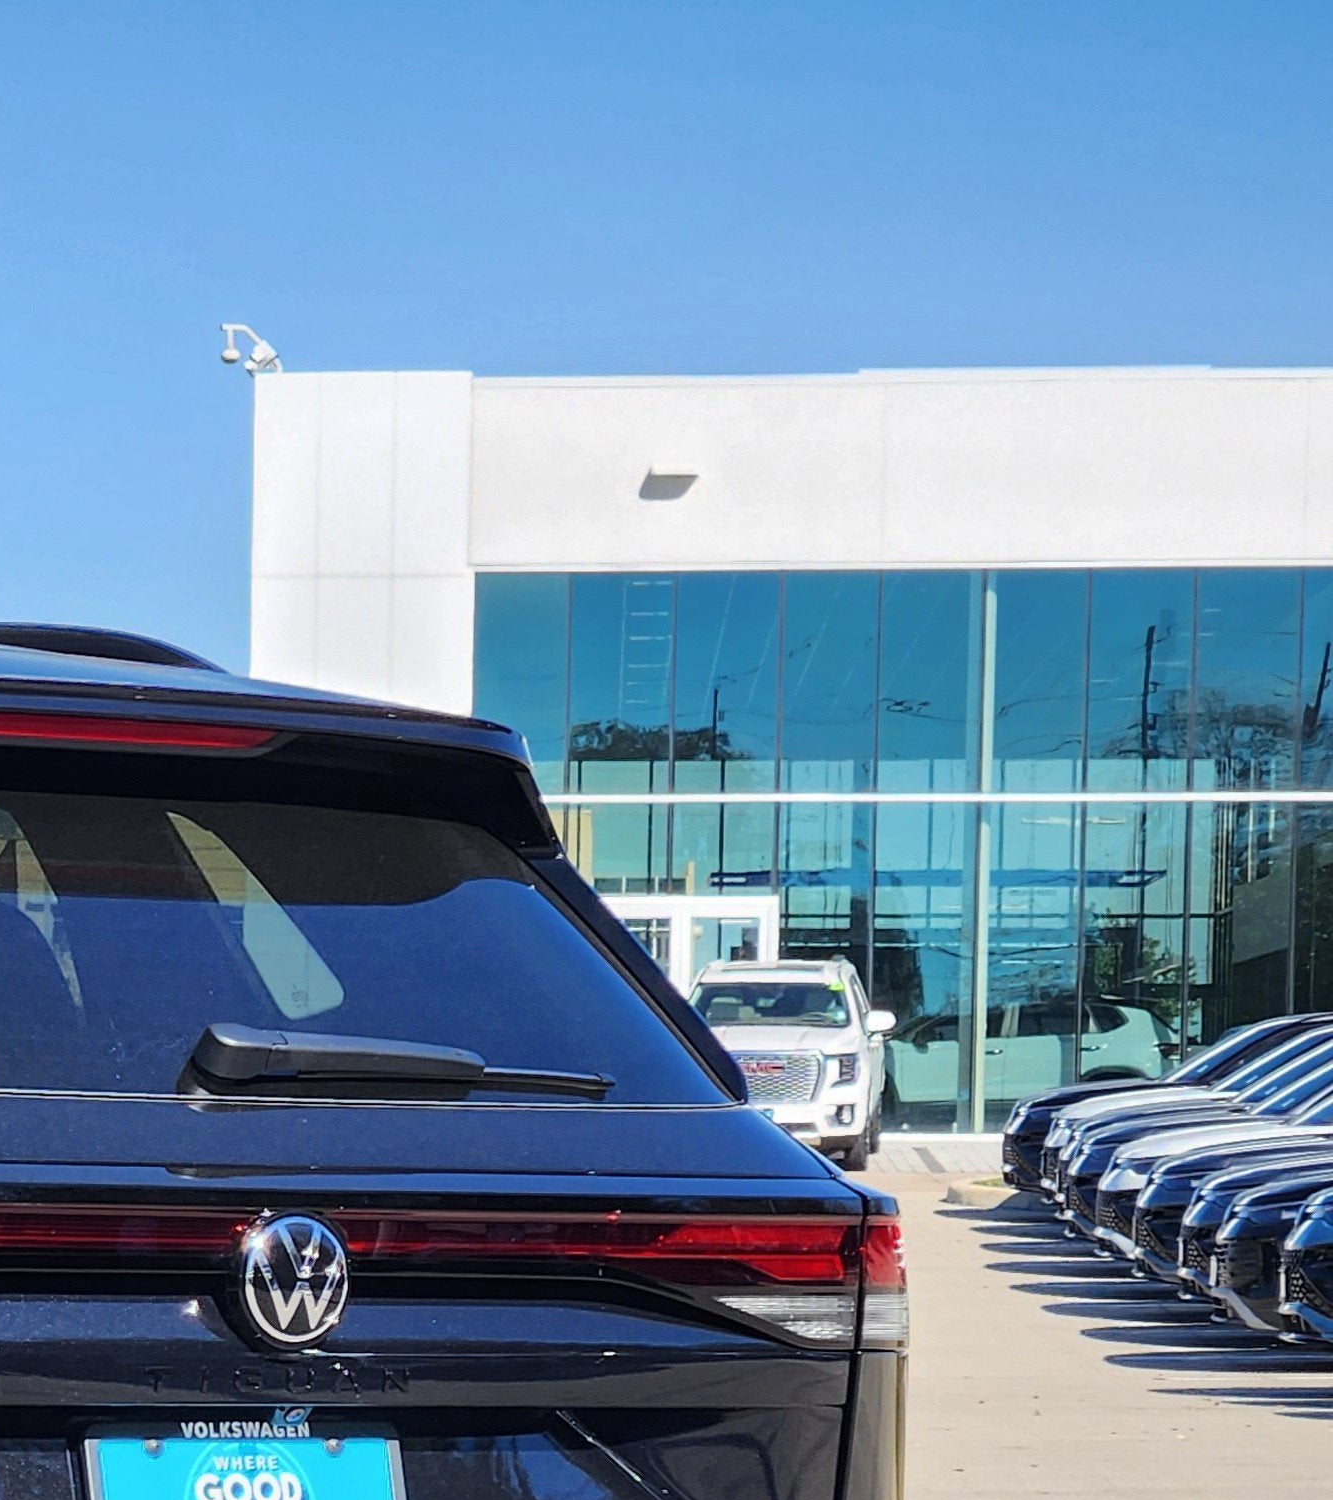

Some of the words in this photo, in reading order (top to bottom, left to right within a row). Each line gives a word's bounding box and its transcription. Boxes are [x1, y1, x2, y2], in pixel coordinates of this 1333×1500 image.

[248, 1216, 346, 1339] VW
[144, 1363, 411, 1398] TIGUAN
[180, 1421, 310, 1439] VOLKSWAGEN
[213, 1455, 279, 1471] WHERE
